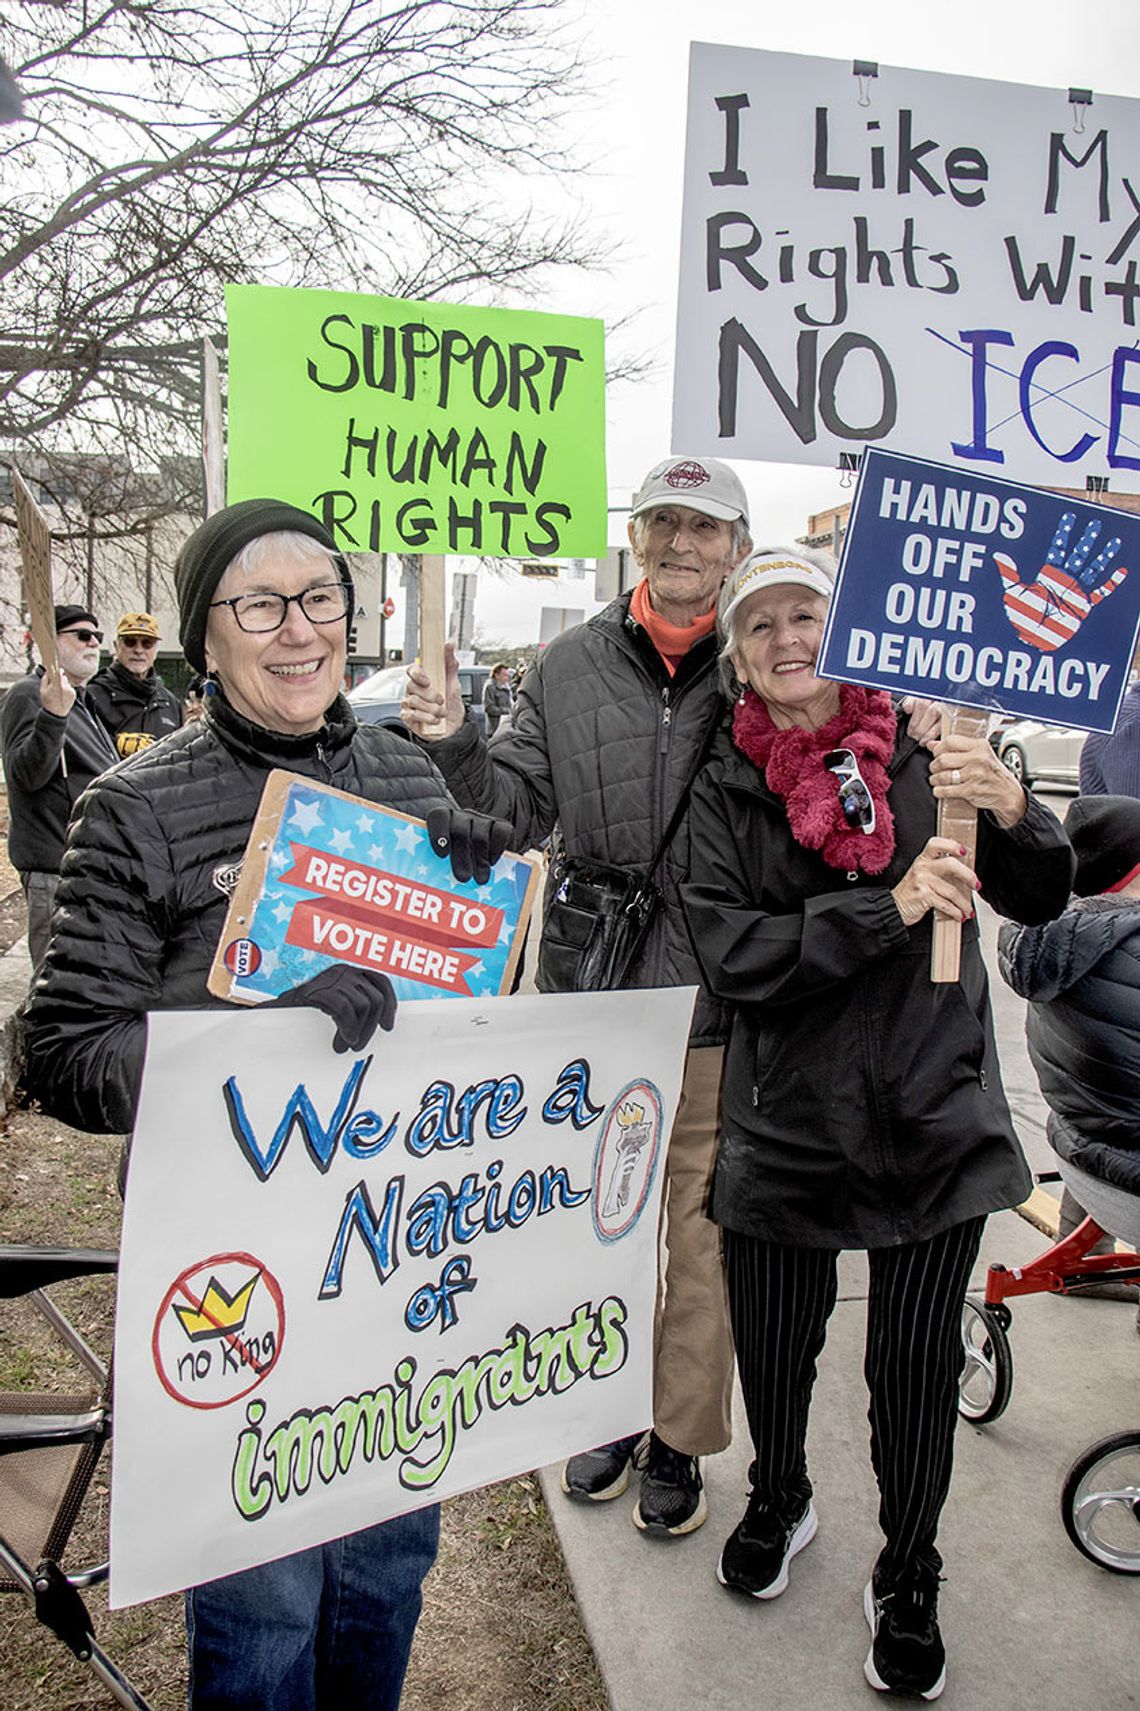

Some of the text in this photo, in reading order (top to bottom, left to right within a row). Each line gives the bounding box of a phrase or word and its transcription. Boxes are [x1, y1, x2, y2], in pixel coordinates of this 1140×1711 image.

[709, 93, 750, 186] I
[813, 106, 988, 207] Like
[706, 211, 959, 326] Rights
[307, 314, 584, 414] SUPPORT
[718, 316, 1140, 468] NO ICE
[340, 418, 547, 496] HUMAN
[312, 490, 572, 556] RIGHTS
[879, 477, 1027, 539] HANDS
[902, 533, 986, 582] OFF
[885, 582, 976, 633] OUR
[846, 627, 1110, 700] DEMOCRACY
[305, 856, 486, 935] REGISTER TO
[238, 942, 249, 973] VOTE
[312, 915, 459, 982] VOTE HERE
[222, 1054, 605, 1183] We are a
[317, 1159, 591, 1300] Nation
[404, 1255, 478, 1335] of
[177, 1351, 211, 1382] no
[232, 1295, 628, 1521] immigrants
